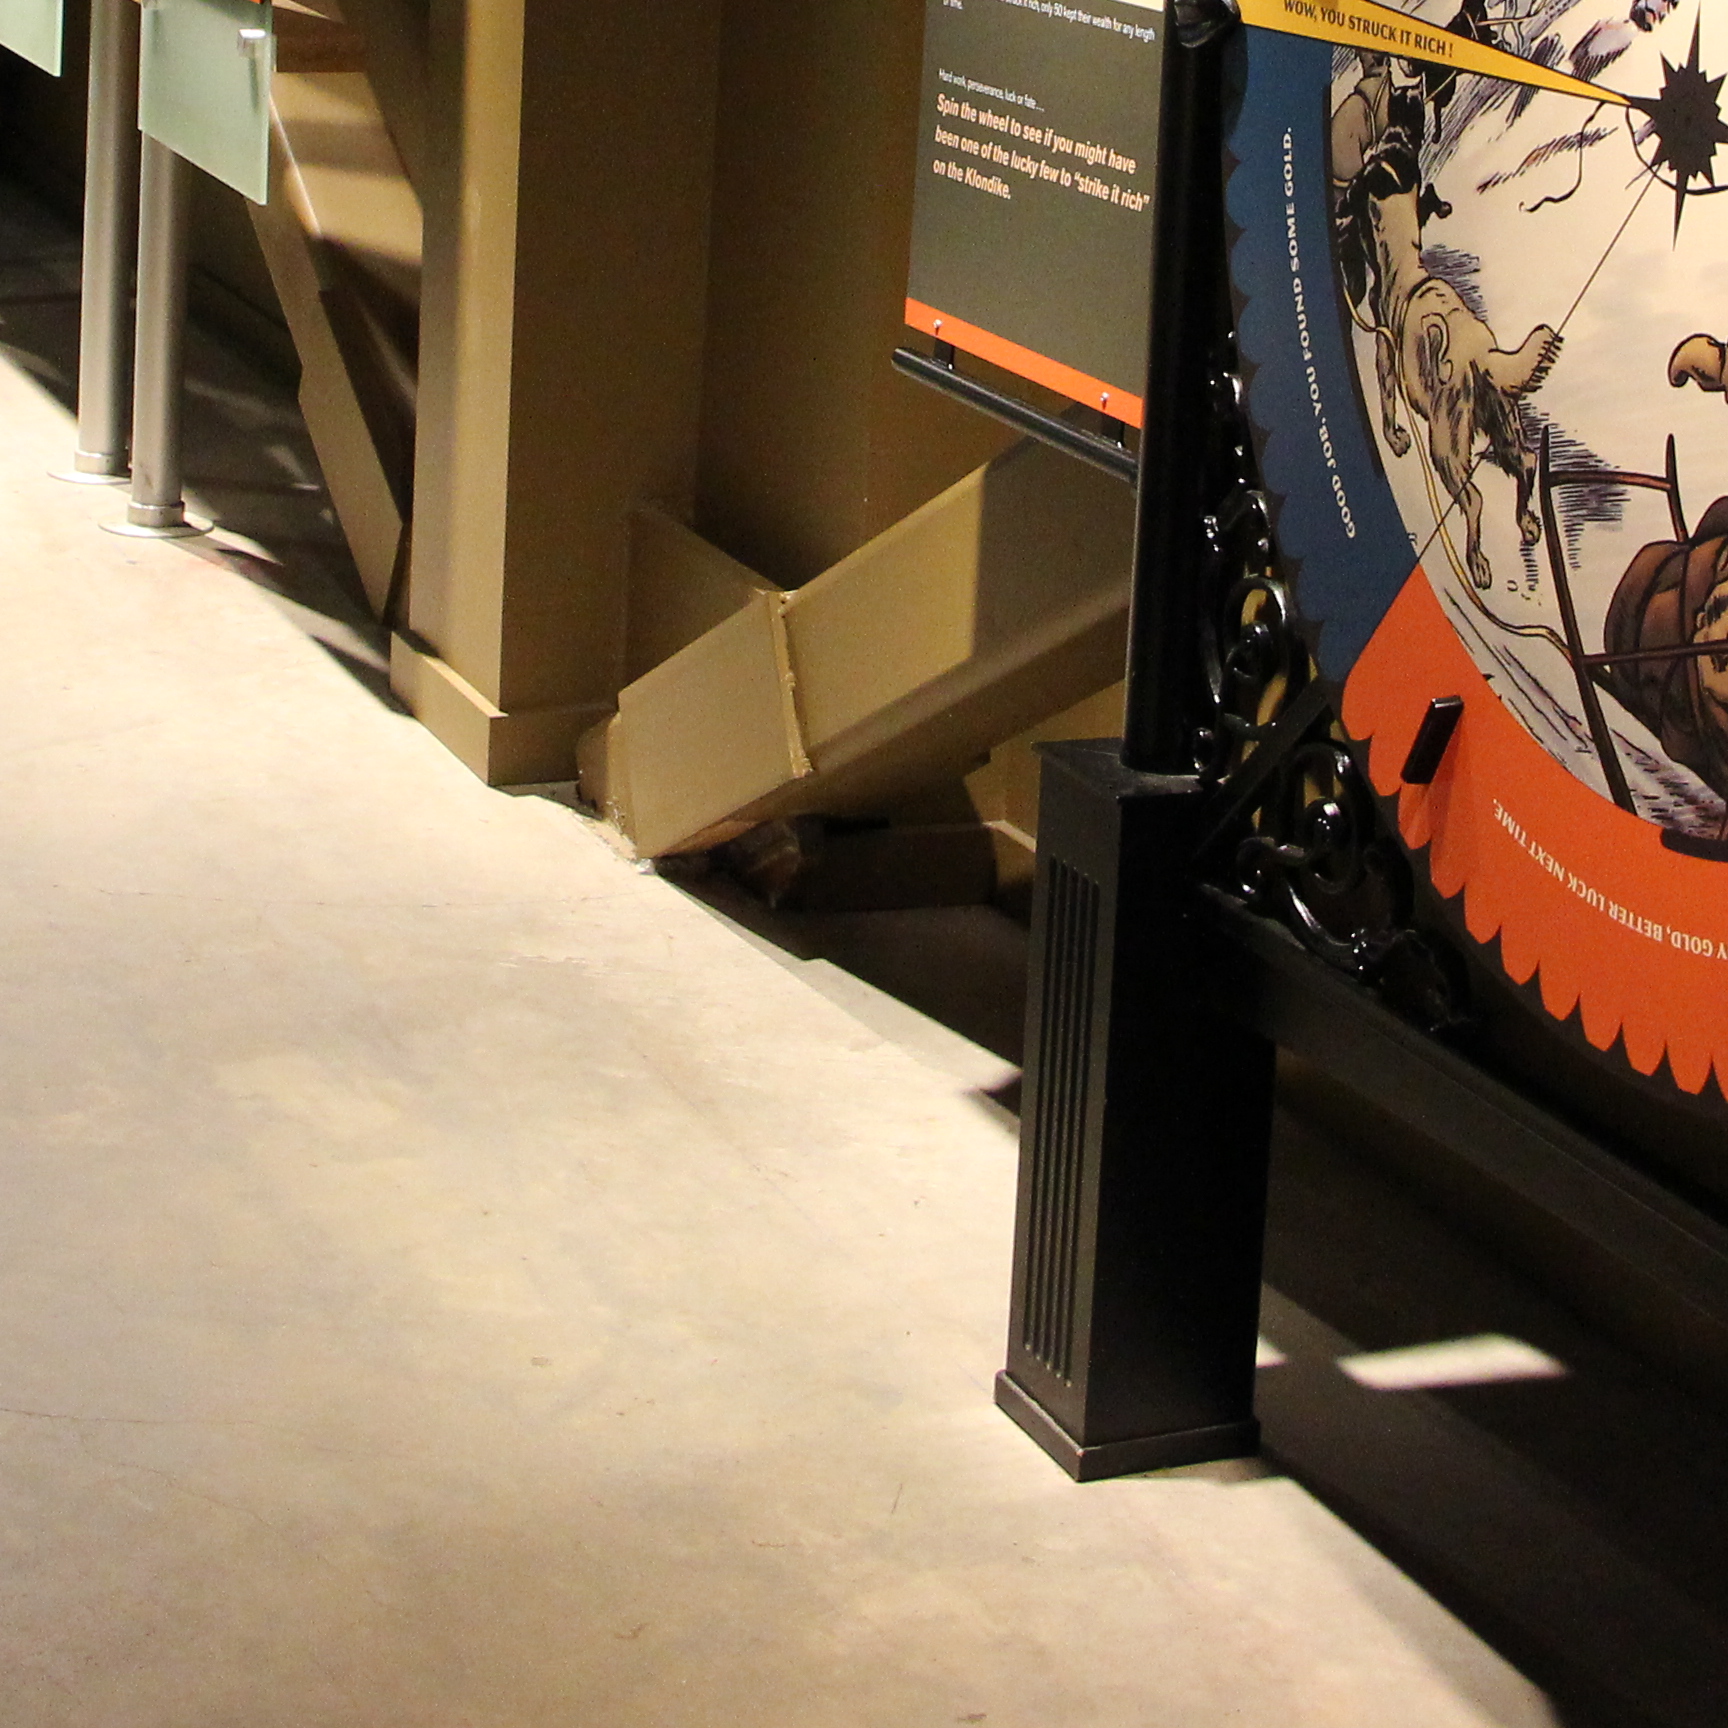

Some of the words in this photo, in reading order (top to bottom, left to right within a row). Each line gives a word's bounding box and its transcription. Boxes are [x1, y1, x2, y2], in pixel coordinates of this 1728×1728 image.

[1321, 7, 1345, 27] YOU
[1349, 16, 1397, 42] STRUCK
[1400, 30, 1411, 46] IT
[935, 125, 959, 148] been
[961, 136, 979, 156] one
[993, 145, 1009, 165] the
[1011, 150, 1039, 178] lucky
[1039, 160, 1059, 183] few
[937, 93, 959, 117] Spin
[961, 102, 977, 122] the
[979, 110, 1009, 132] wheel
[1023, 126, 1042, 143] see
[1052, 134, 1073, 154] you
[1074, 141, 1107, 165] might
[1108, 149, 1136, 174] have
[947, 161, 963, 182] the
[965, 167, 1011, 199] Klondike.
[1283, 127, 1294, 197] GOLD.
[1285, 202, 1299, 272] SOME
[1293, 277, 1312, 361] FOUND
[1306, 366, 1322, 417] YOU
[1332, 474, 1355, 539] GOOD
[1493, 799, 1528, 848] TIME.
[1528, 841, 1565, 882] NEXT
[1567, 873, 1605, 912] LUCK
[1609, 901, 1663, 942] BETTER
[1666, 925, 1714, 958] GOLD,
